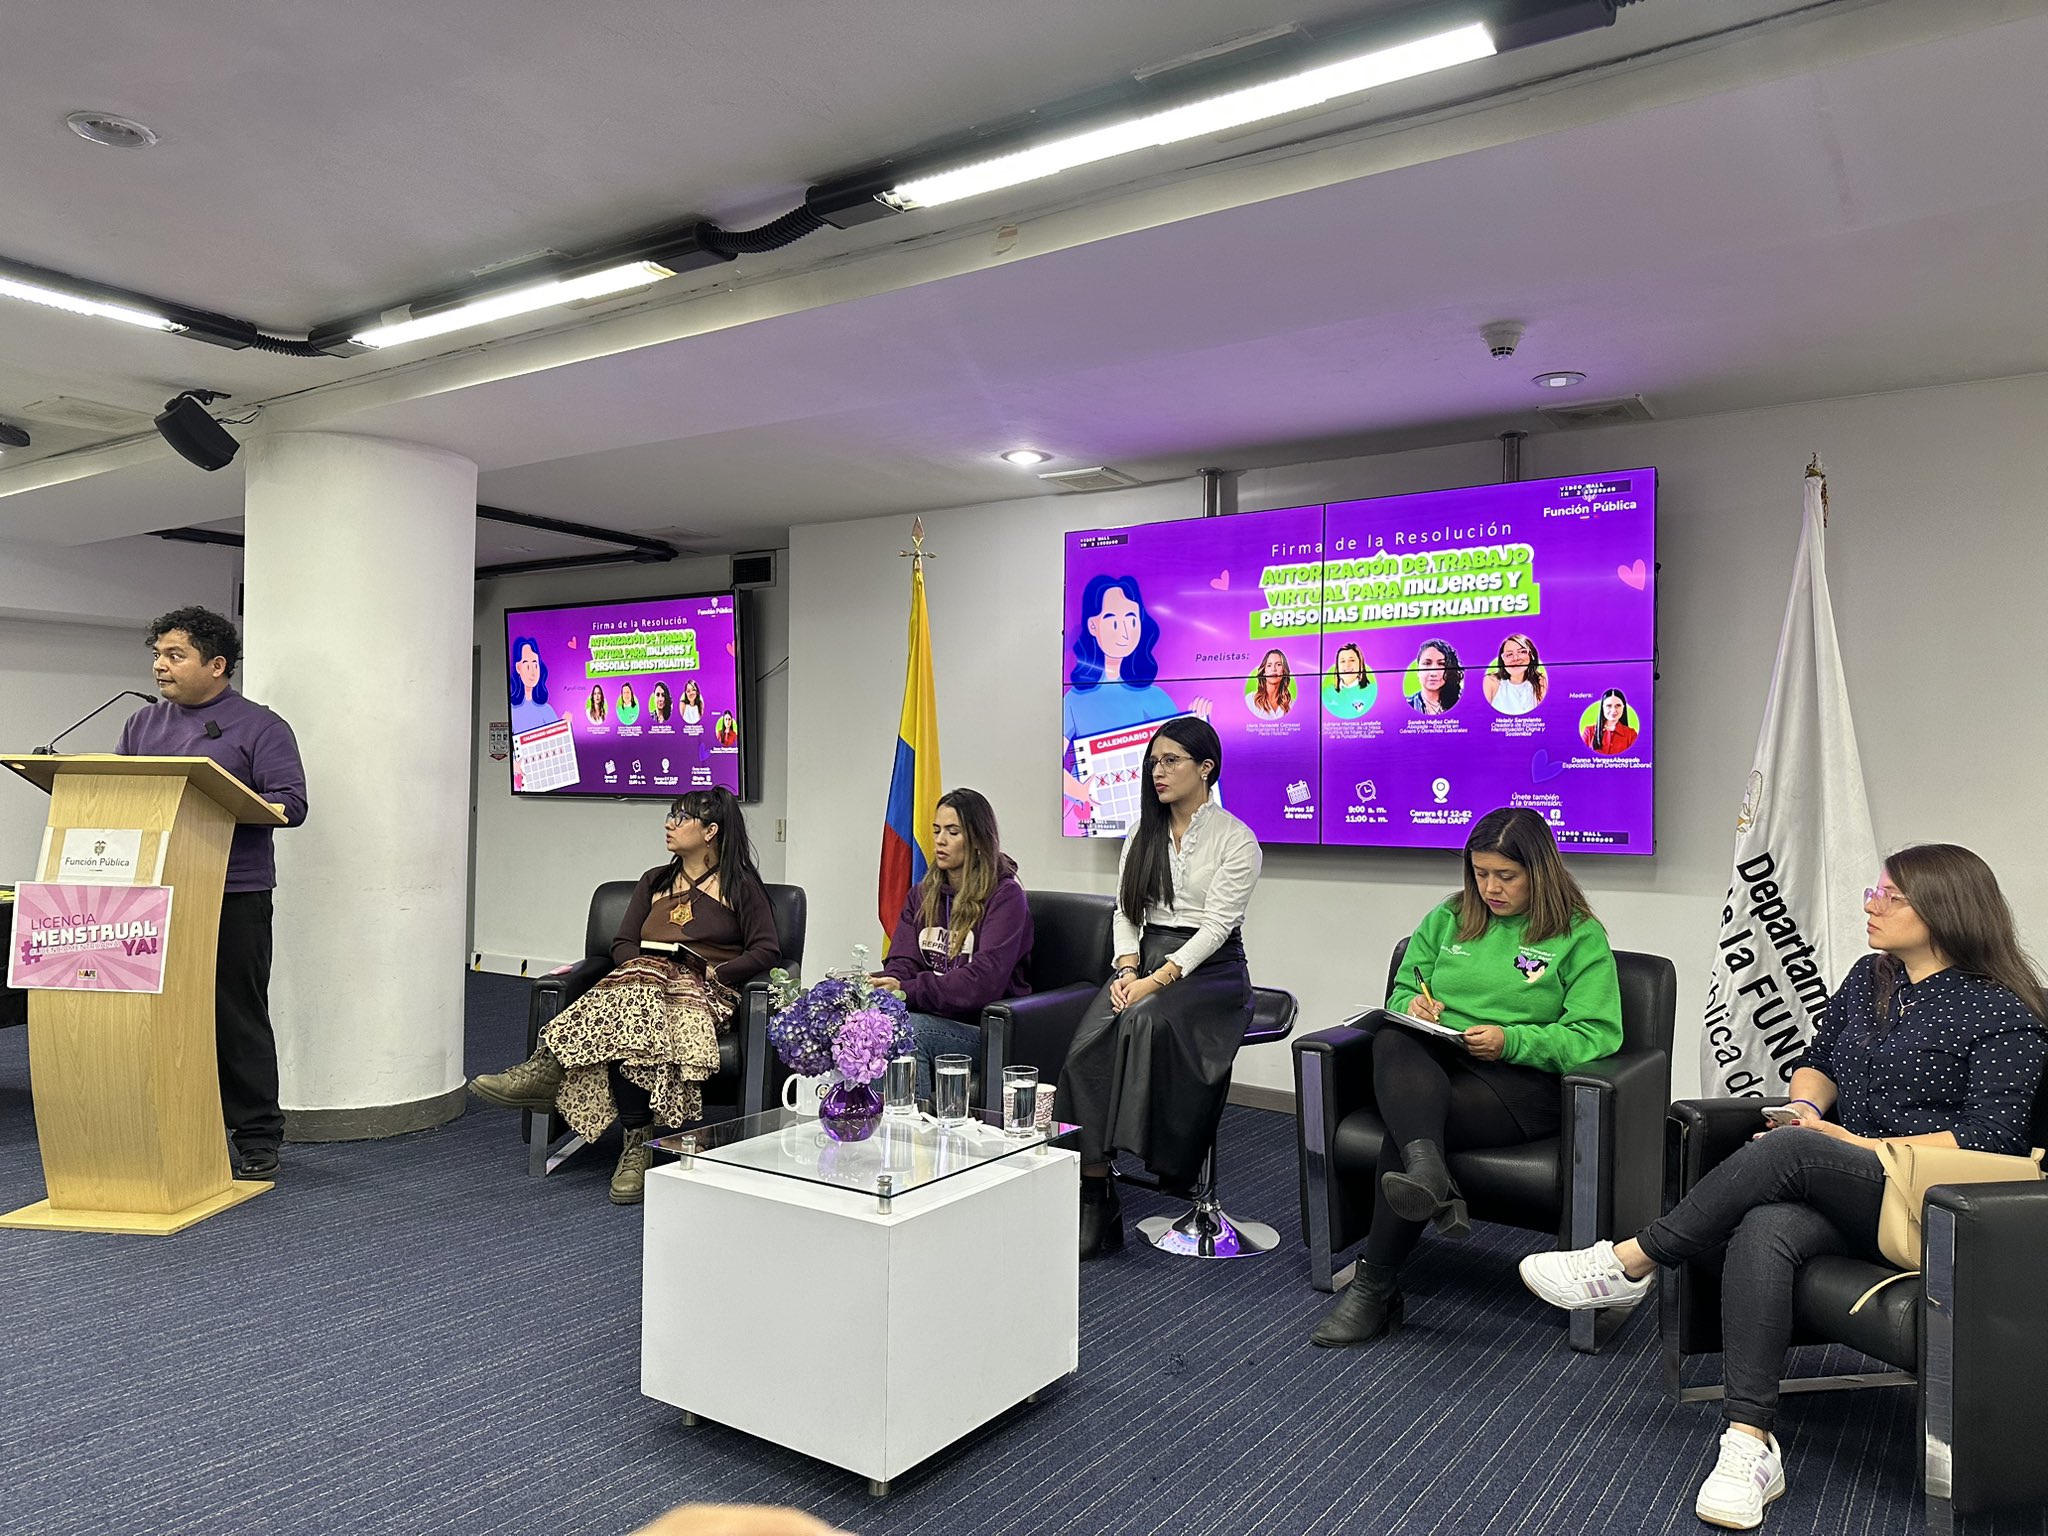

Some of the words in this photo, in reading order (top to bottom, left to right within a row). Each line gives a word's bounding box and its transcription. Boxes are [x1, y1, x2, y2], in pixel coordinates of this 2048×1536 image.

[1543, 504, 1590, 518] Función
[1593, 500, 1637, 512] Pública
[1272, 543, 1323, 557] Firma
[1335, 537, 1357, 551] de
[1367, 534, 1384, 548] la
[1395, 522, 1512, 545] Resolución
[1432, 547, 1529, 571] TRABAJO
[1267, 586, 1345, 607] VIRTUAL
[1348, 580, 1401, 600] PARA
[1506, 571, 1522, 589] Y
[592, 622, 614, 630] Firma
[618, 620, 627, 629] de
[631, 620, 638, 628] la
[642, 615, 688, 627] Resolución
[658, 632, 694, 644] TRABAJO
[593, 648, 625, 659] VIRTUAL
[626, 647, 646, 658] PARA
[685, 644, 692, 655] Y
[1195, 652, 1250, 662] Panelistas:
[1096, 732, 1148, 749] CALENDARIO
[1512, 792, 1531, 800] Únete
[65, 856, 97, 866] Función
[100, 857, 130, 867] Pública
[31, 914, 96, 930] LICENCIA
[31, 920, 158, 948] MENSTRUAL
[122, 938, 158, 956] YA!
[1719, 928, 1755, 974] la
